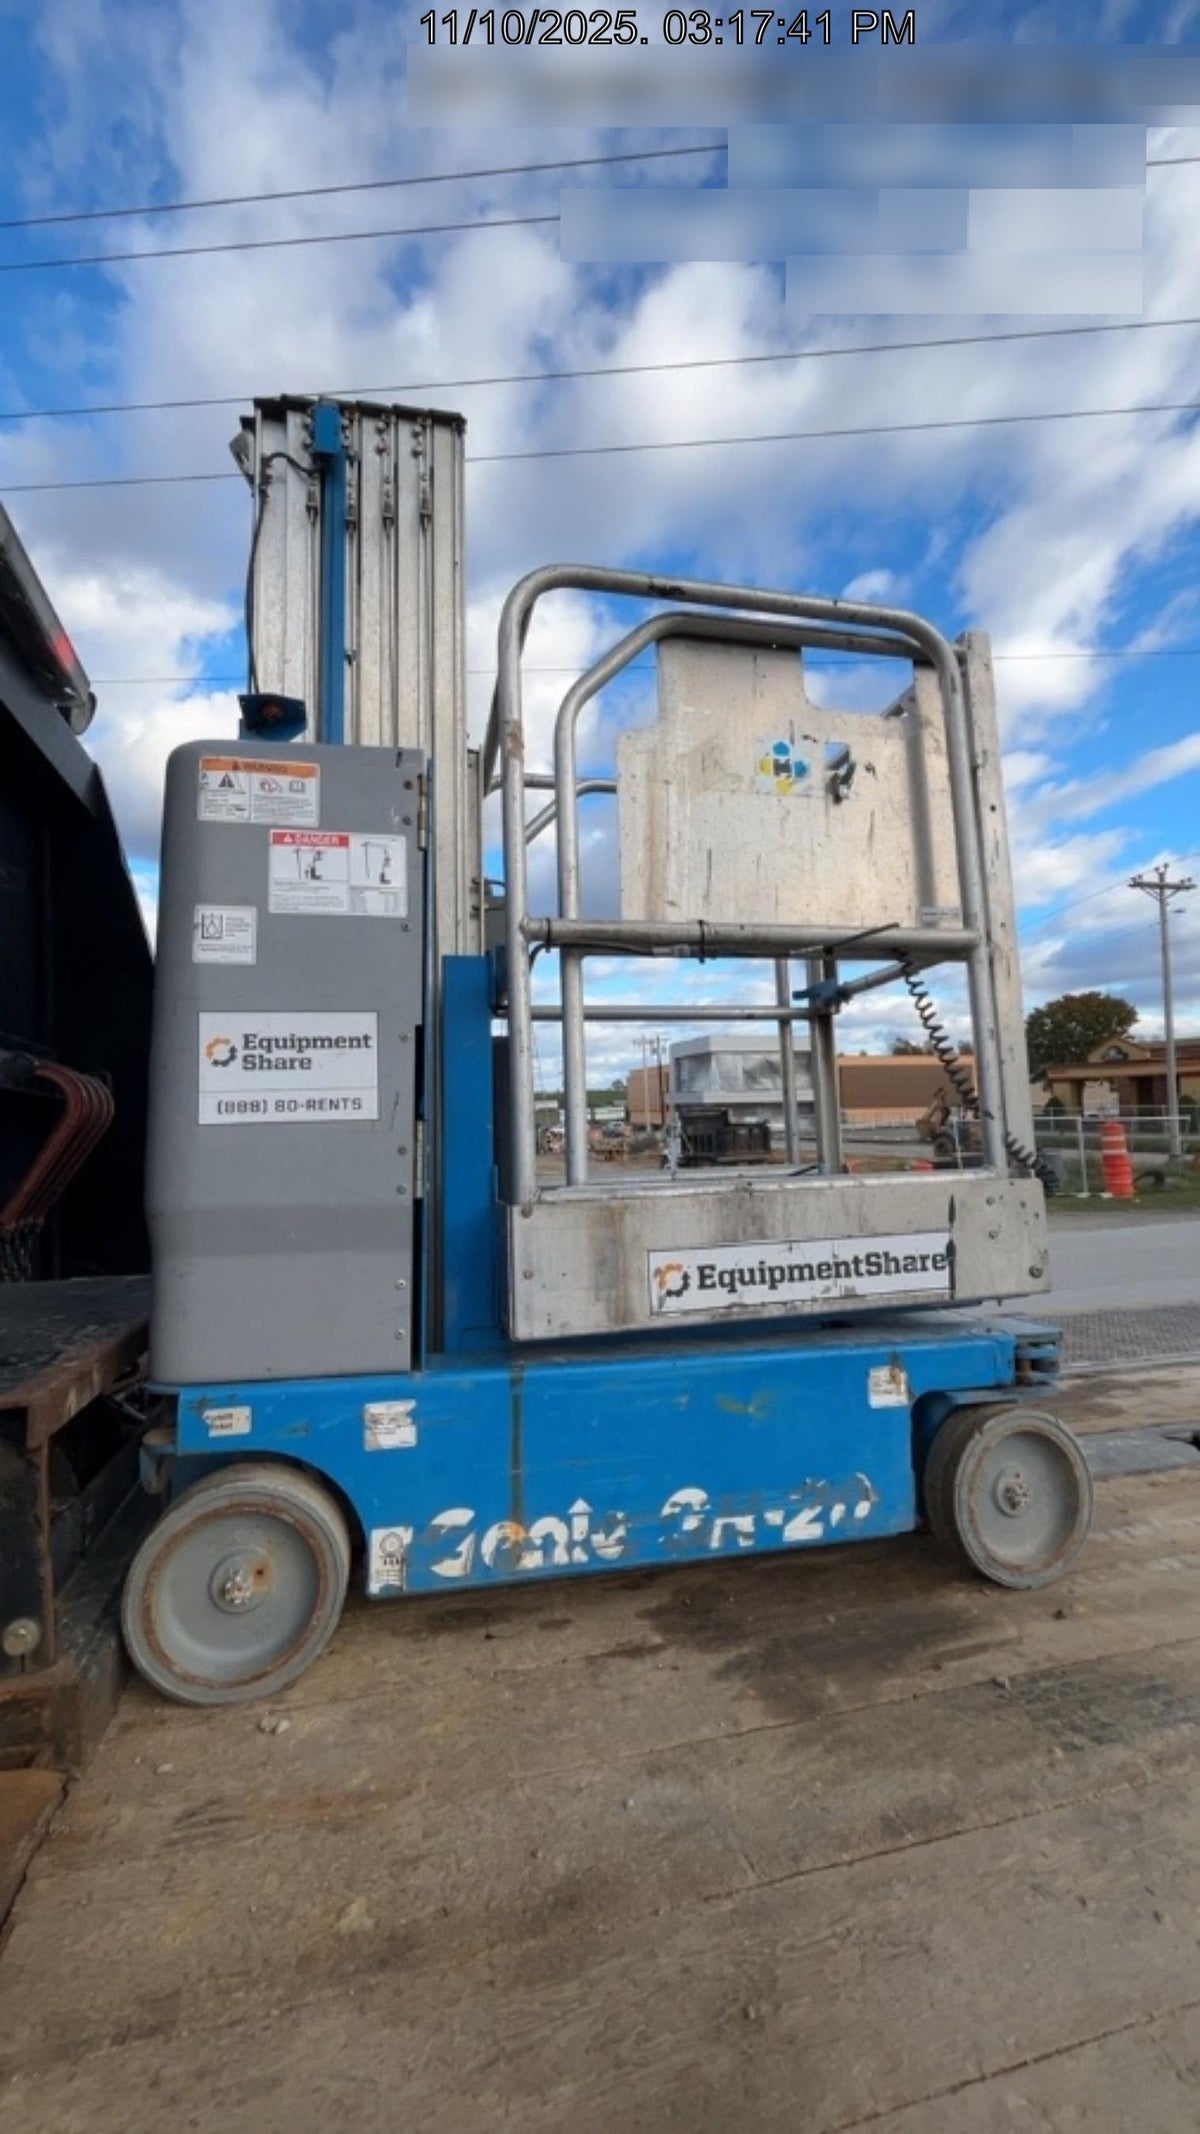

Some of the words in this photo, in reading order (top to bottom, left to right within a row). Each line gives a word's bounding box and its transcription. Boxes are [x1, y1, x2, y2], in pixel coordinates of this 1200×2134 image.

[242, 1033, 373, 1053] Equipment
[242, 1054, 312, 1070] Share
[217, 1099, 269, 1115] (888)
[274, 1097, 363, 1113] 80-RENTS
[697, 1251, 948, 1294] EquipmentShare
